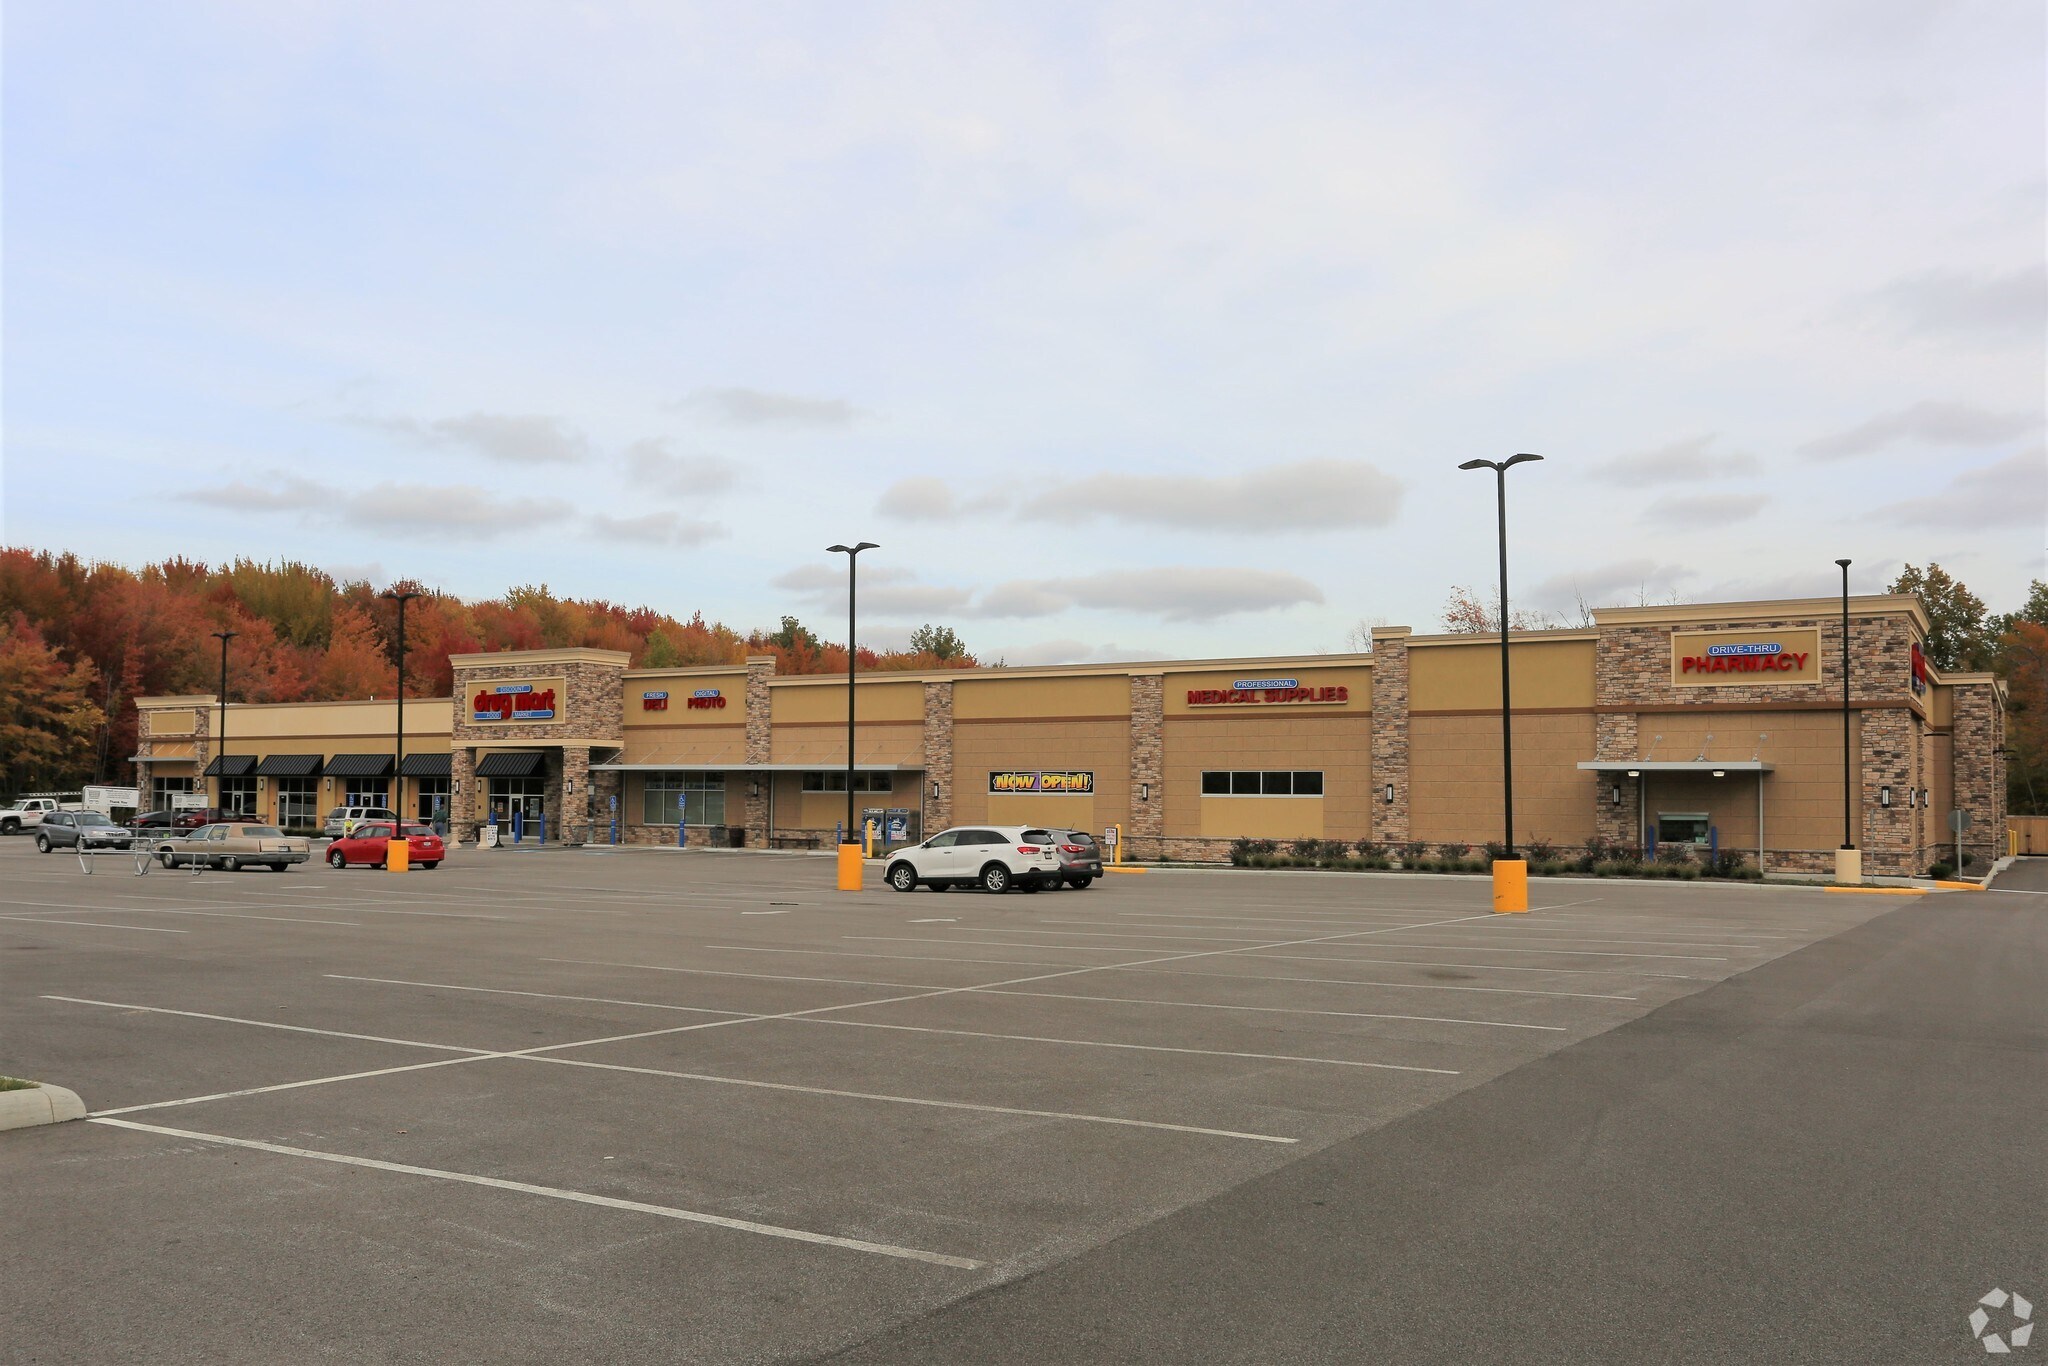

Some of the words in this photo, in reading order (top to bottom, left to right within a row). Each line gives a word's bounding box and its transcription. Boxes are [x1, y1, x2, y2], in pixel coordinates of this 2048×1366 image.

[1712, 645, 1777, 654] DRIVE-THRU
[1682, 653, 1808, 674] PHARMACY
[1237, 680, 1293, 688] PROFESSIONAL
[1187, 689, 1260, 704] MEDICAL
[1264, 686, 1348, 703] SUPPLIES
[474, 690, 512, 719] drug
[515, 688, 555, 711] mart
[643, 698, 668, 710] DELI
[687, 697, 726, 709] PHOTO
[995, 774, 1035, 788] NOW
[1041, 773, 1088, 789] OPEN!
